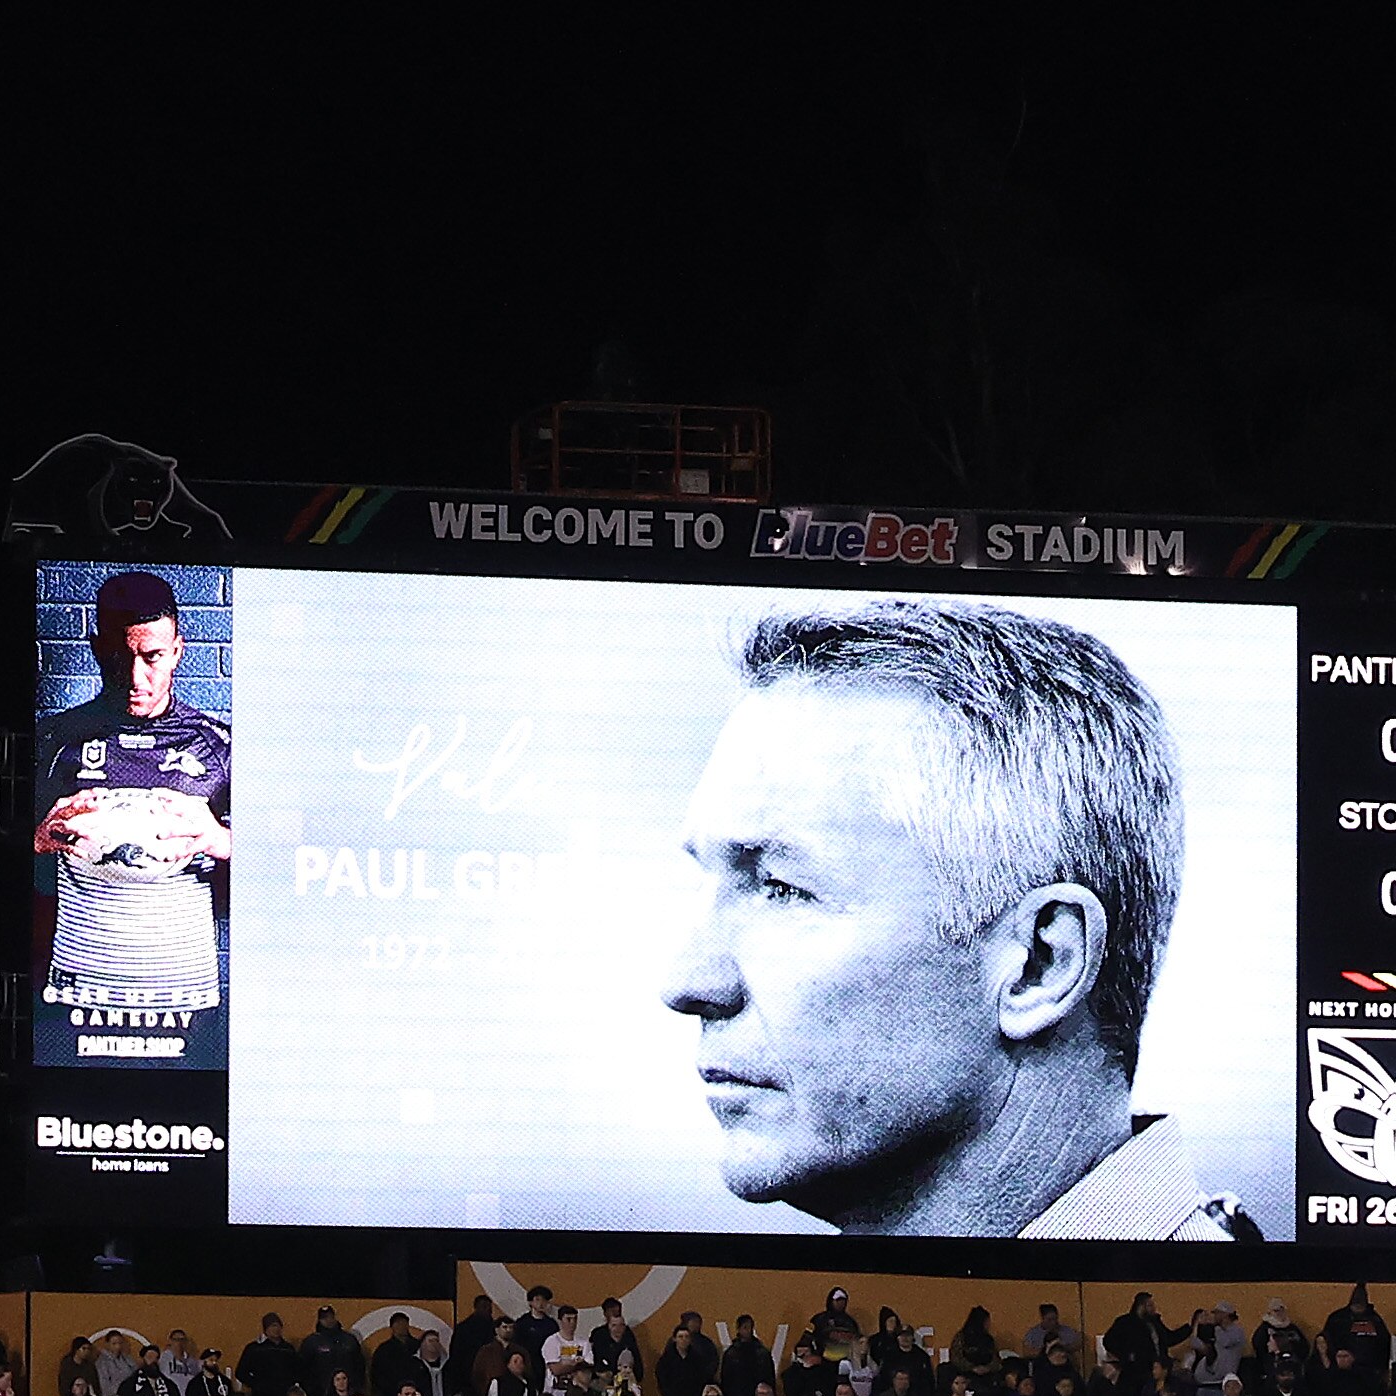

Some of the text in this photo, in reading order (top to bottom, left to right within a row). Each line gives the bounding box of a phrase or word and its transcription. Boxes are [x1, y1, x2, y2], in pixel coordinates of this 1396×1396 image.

[429, 501, 1184, 566] WELCOME TO BlueBet STADIUM
[294, 846, 440, 899] PAUL
[70, 1008, 192, 1028] GAMEDAY
[1309, 1001, 1358, 1019] NEXT
[37, 1116, 225, 1151] Bluestone.
[92, 1157, 169, 1172] home loans
[1307, 1197, 1358, 1224] FRI
